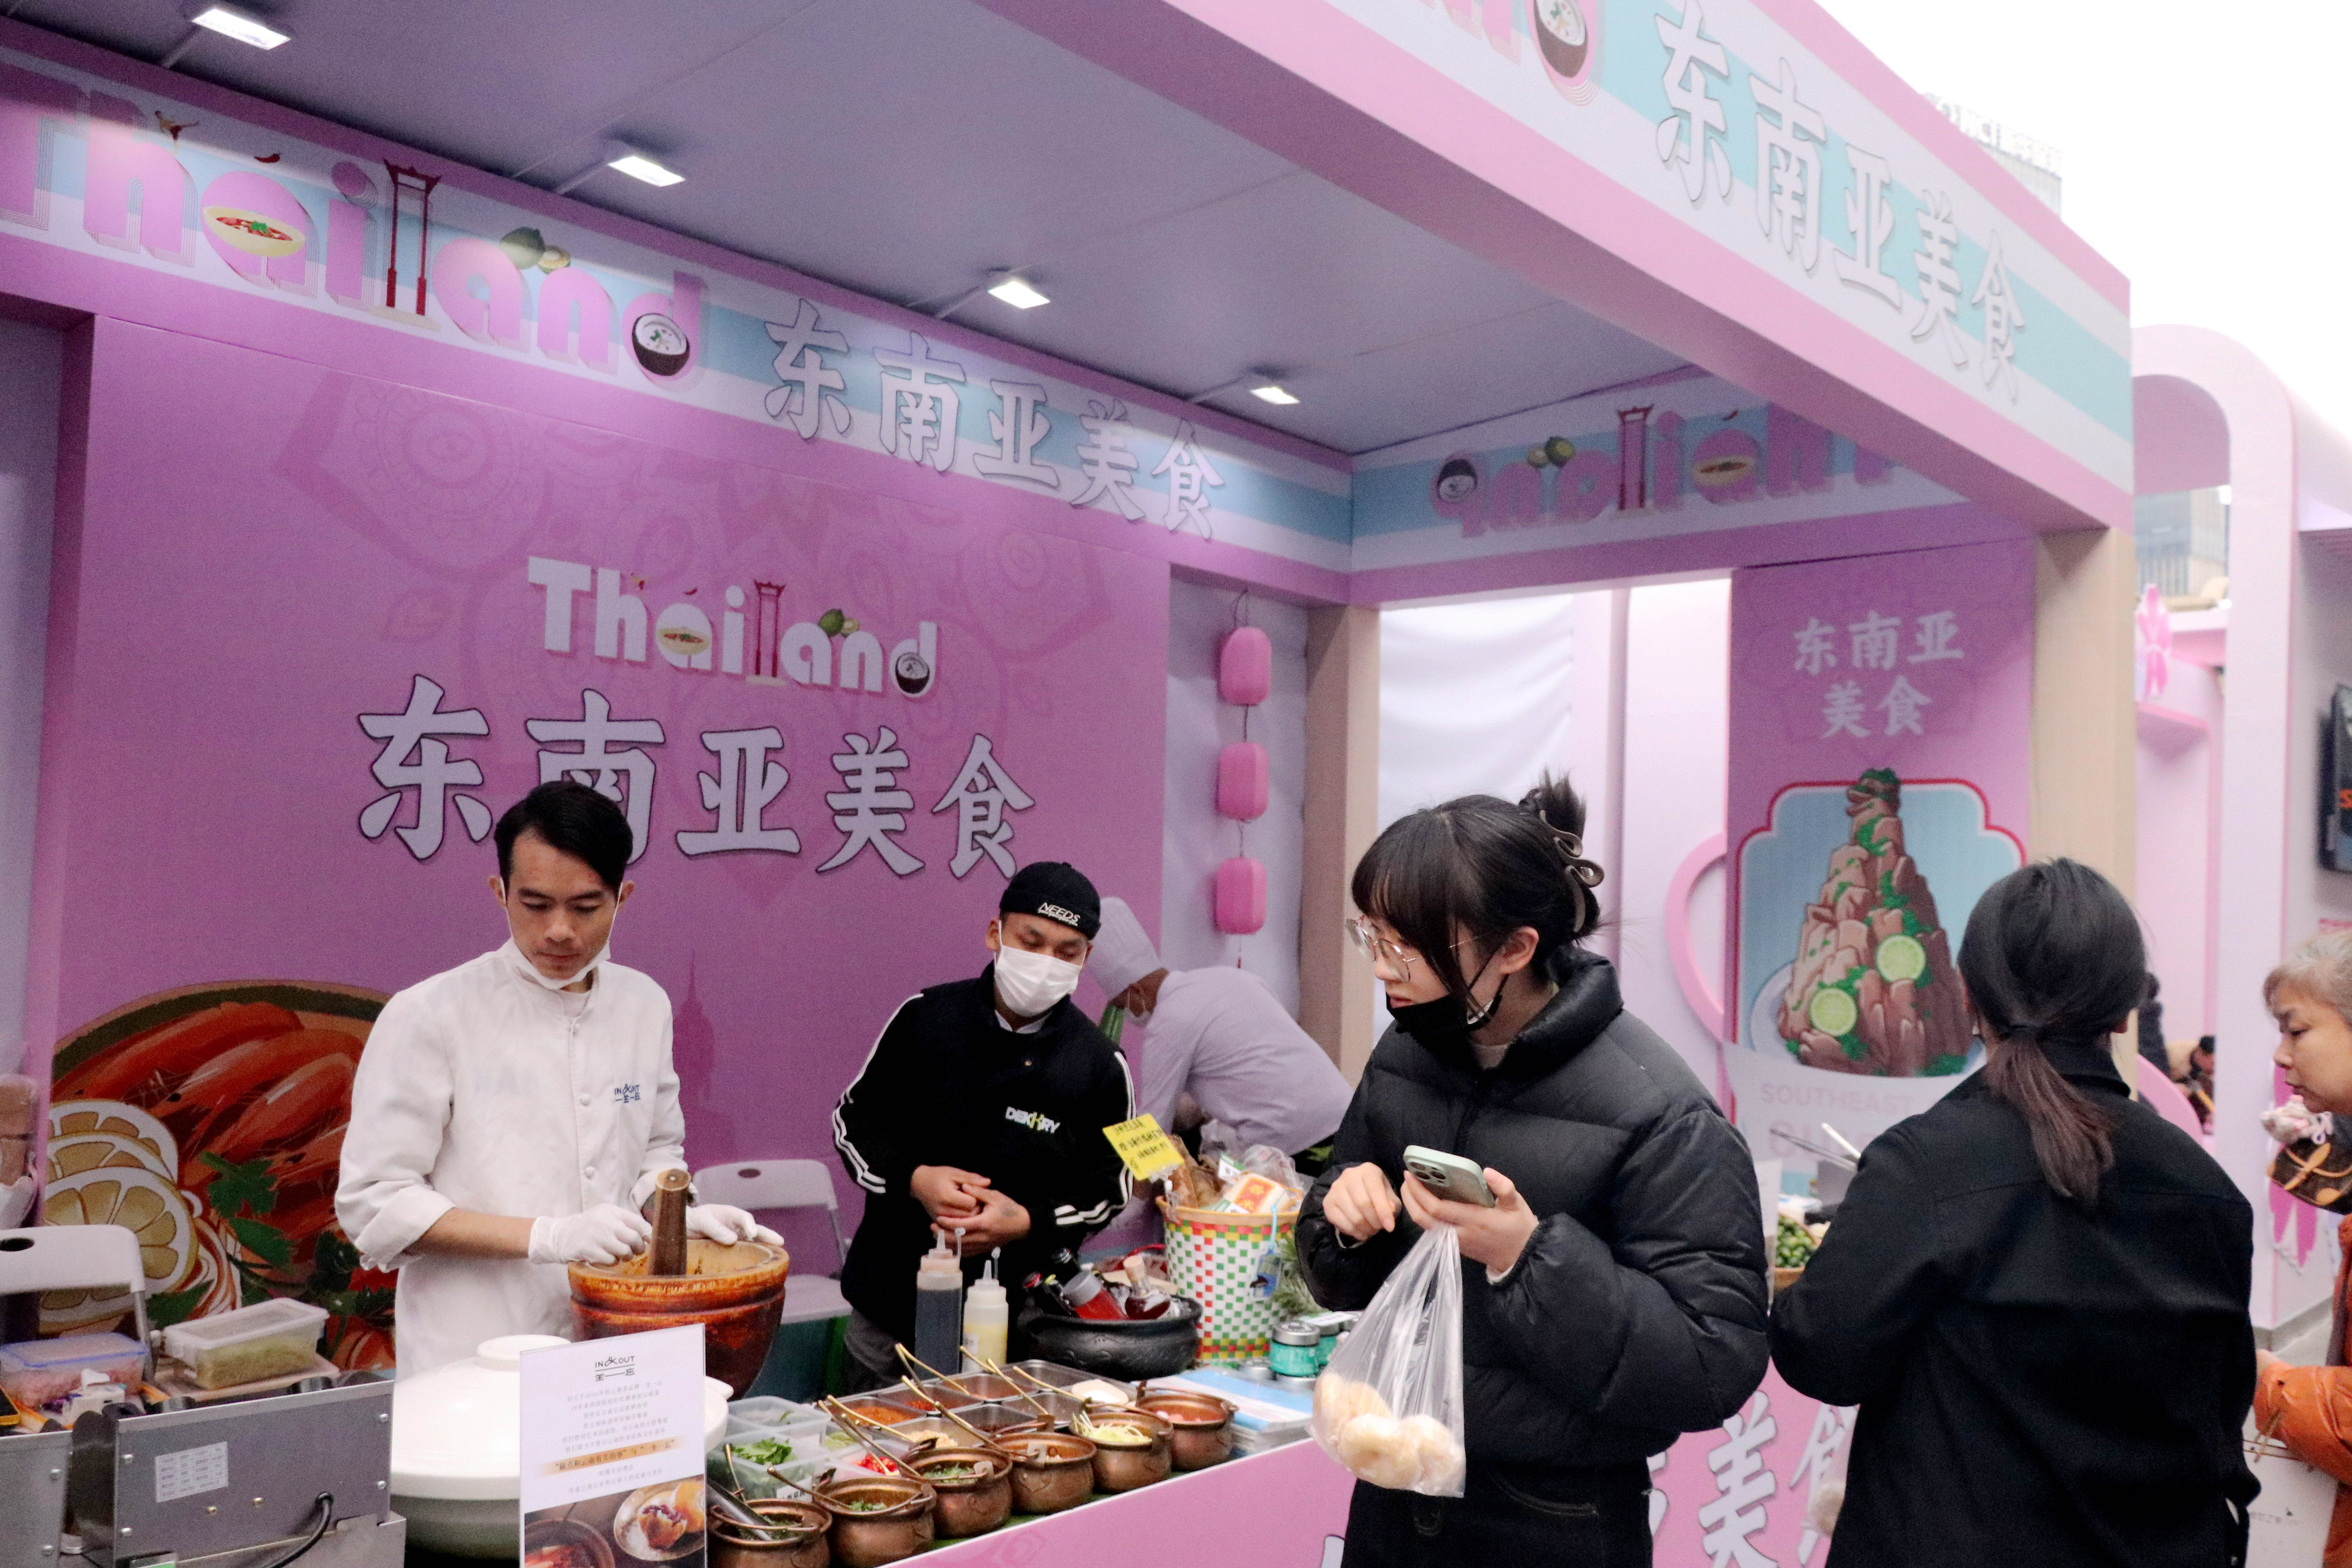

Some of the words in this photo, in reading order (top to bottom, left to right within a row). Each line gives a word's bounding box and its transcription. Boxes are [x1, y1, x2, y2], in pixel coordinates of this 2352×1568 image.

[1655, 0, 2026, 402] 东南亚美食
[764, 298, 1225, 539] 东南亚美食
[528, 555, 938, 697] Thailand
[1793, 610, 1965, 676] 东南亚
[358, 674, 1035, 880] 东南亚美食
[1820, 674, 1933, 739] 美食
[1038, 902, 1081, 922] NEEDS
